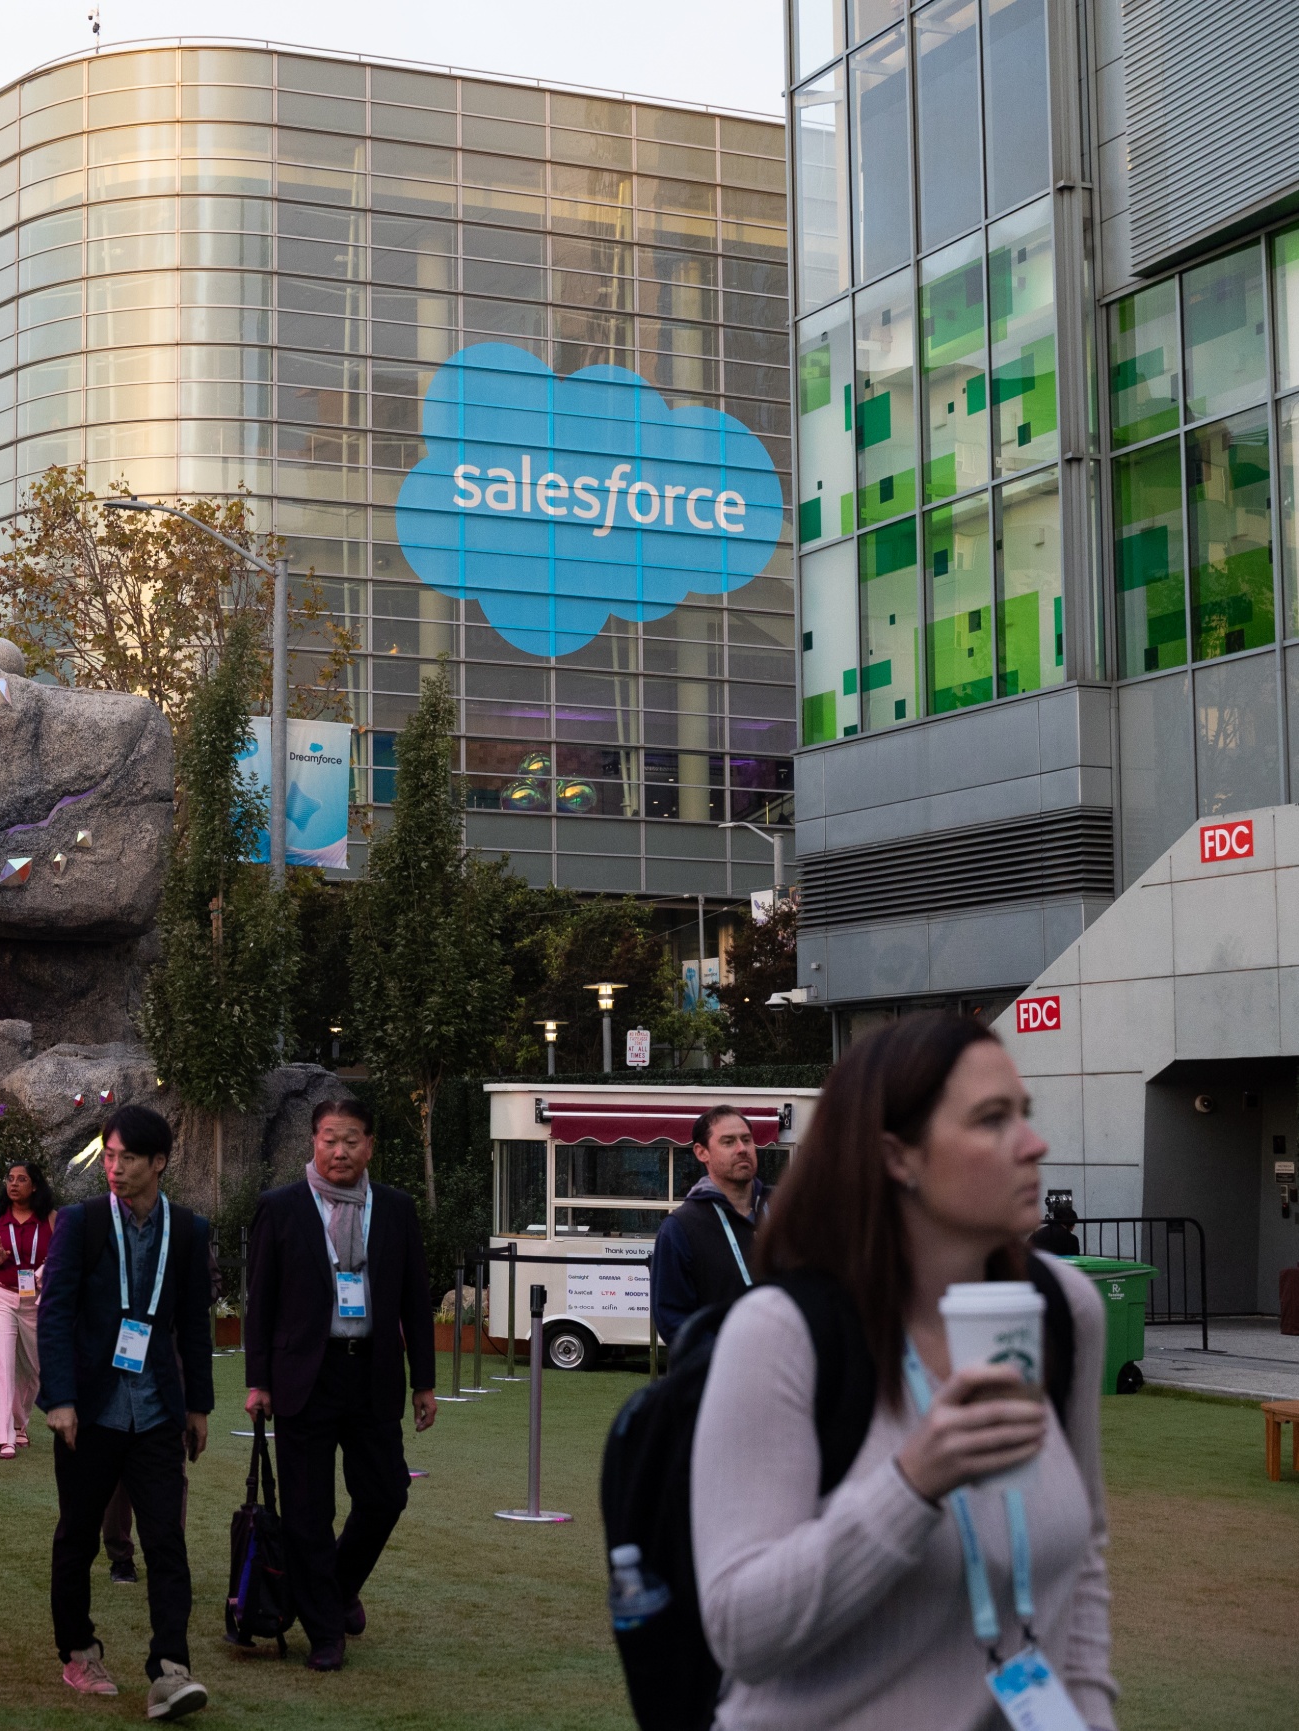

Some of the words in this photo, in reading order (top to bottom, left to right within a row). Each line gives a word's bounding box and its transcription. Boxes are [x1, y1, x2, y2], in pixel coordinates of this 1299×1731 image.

[453, 455, 746, 537] salesforce
[289, 752, 343, 765] Dreamforce
[1204, 825, 1250, 859] FDC
[1019, 1000, 1058, 1029] FDC
